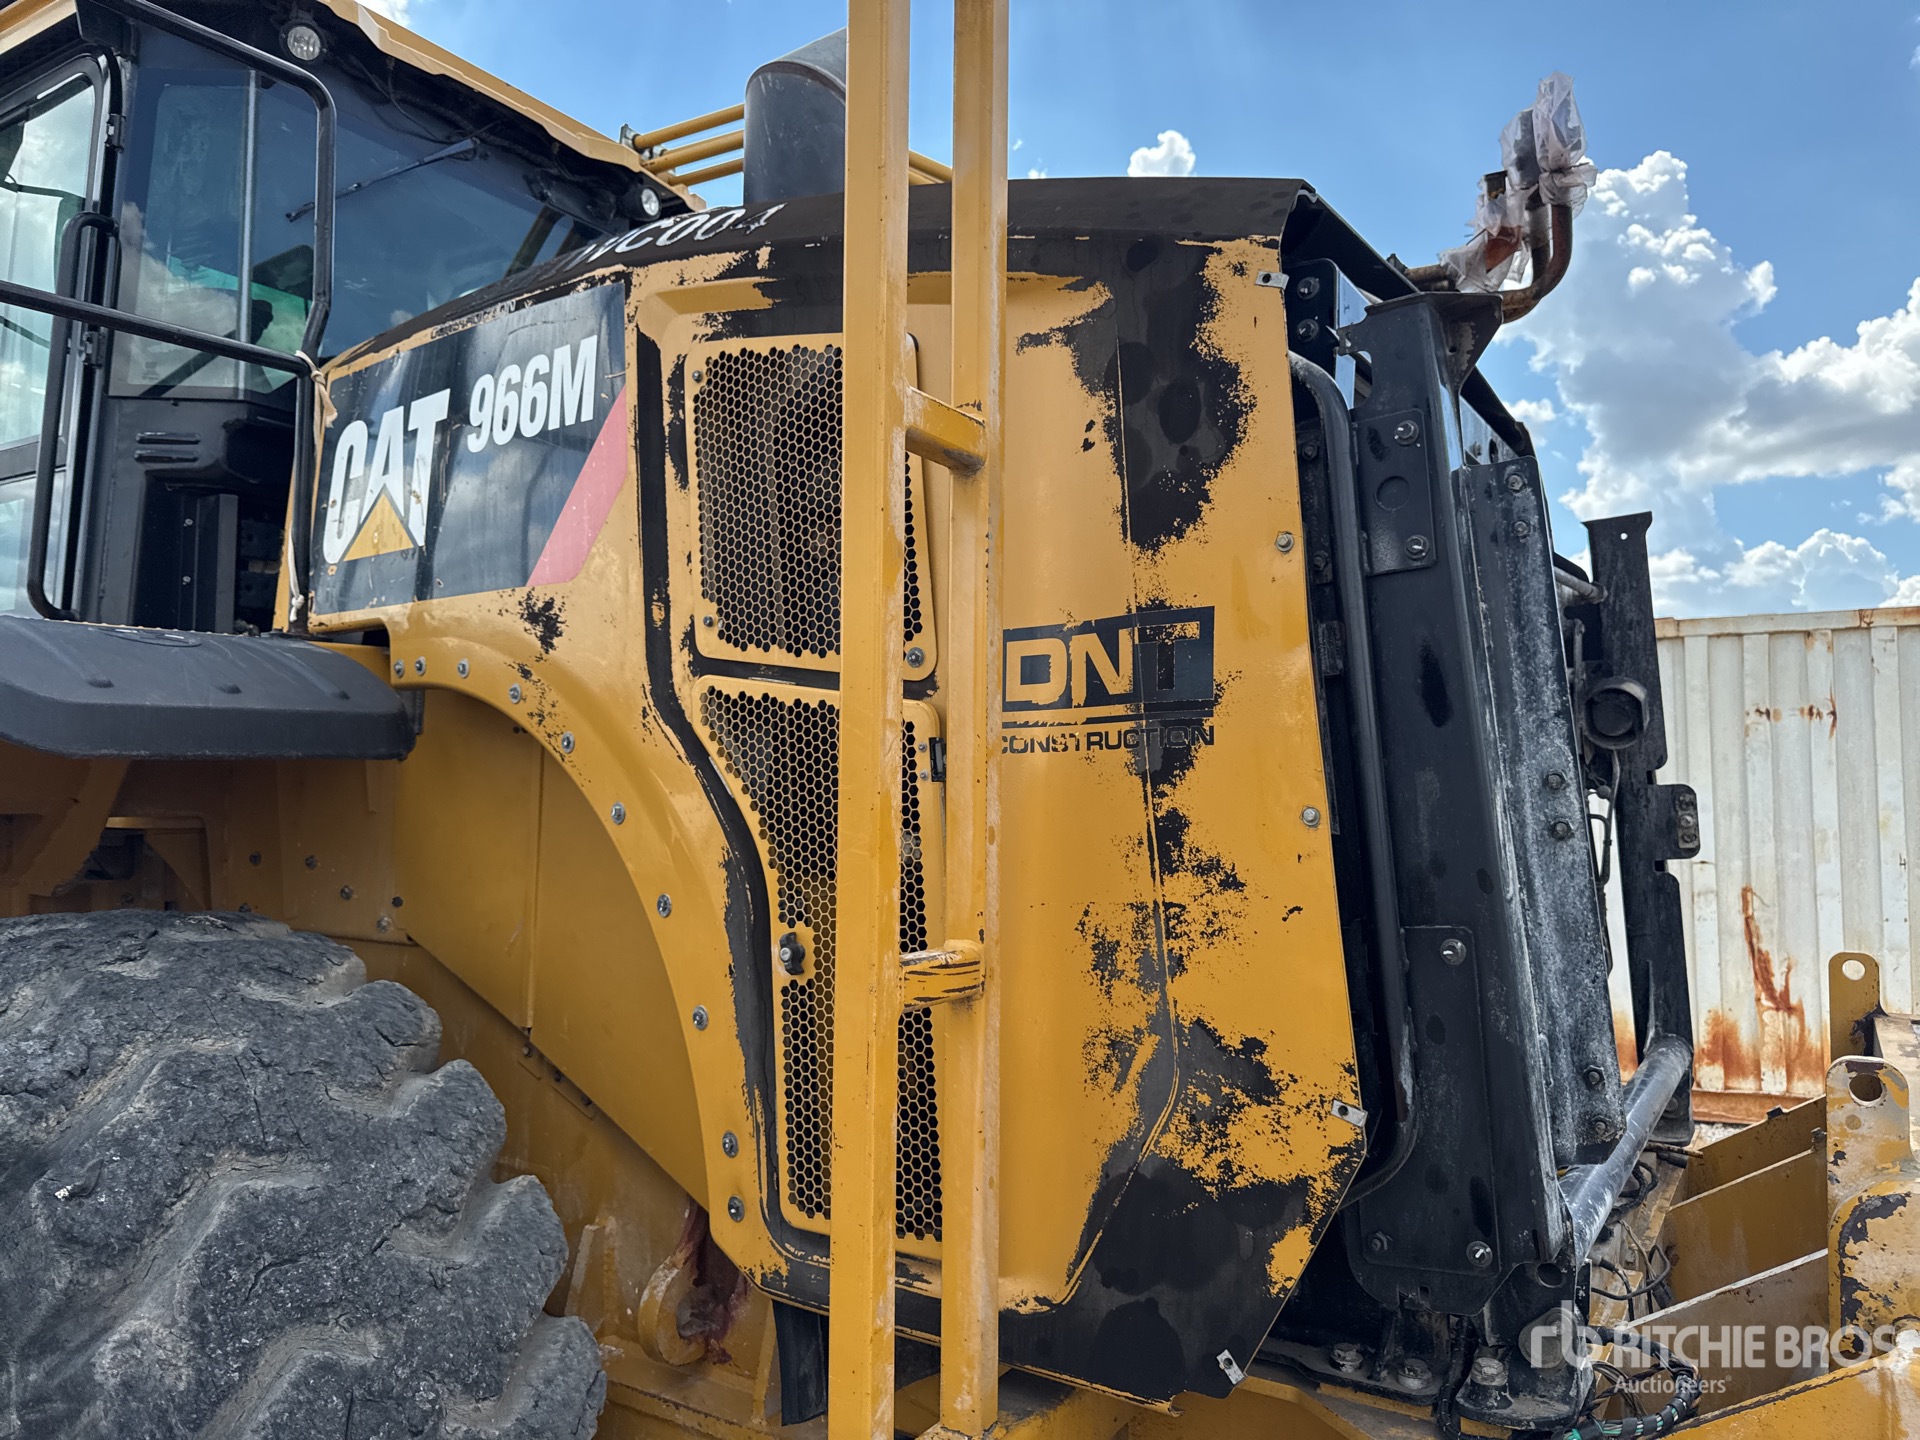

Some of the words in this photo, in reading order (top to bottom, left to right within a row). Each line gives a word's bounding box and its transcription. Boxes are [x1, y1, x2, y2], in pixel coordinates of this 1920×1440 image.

[322, 387, 451, 565] CAT
[466, 334, 598, 454] 966M
[1005, 620, 1201, 704] DNT
